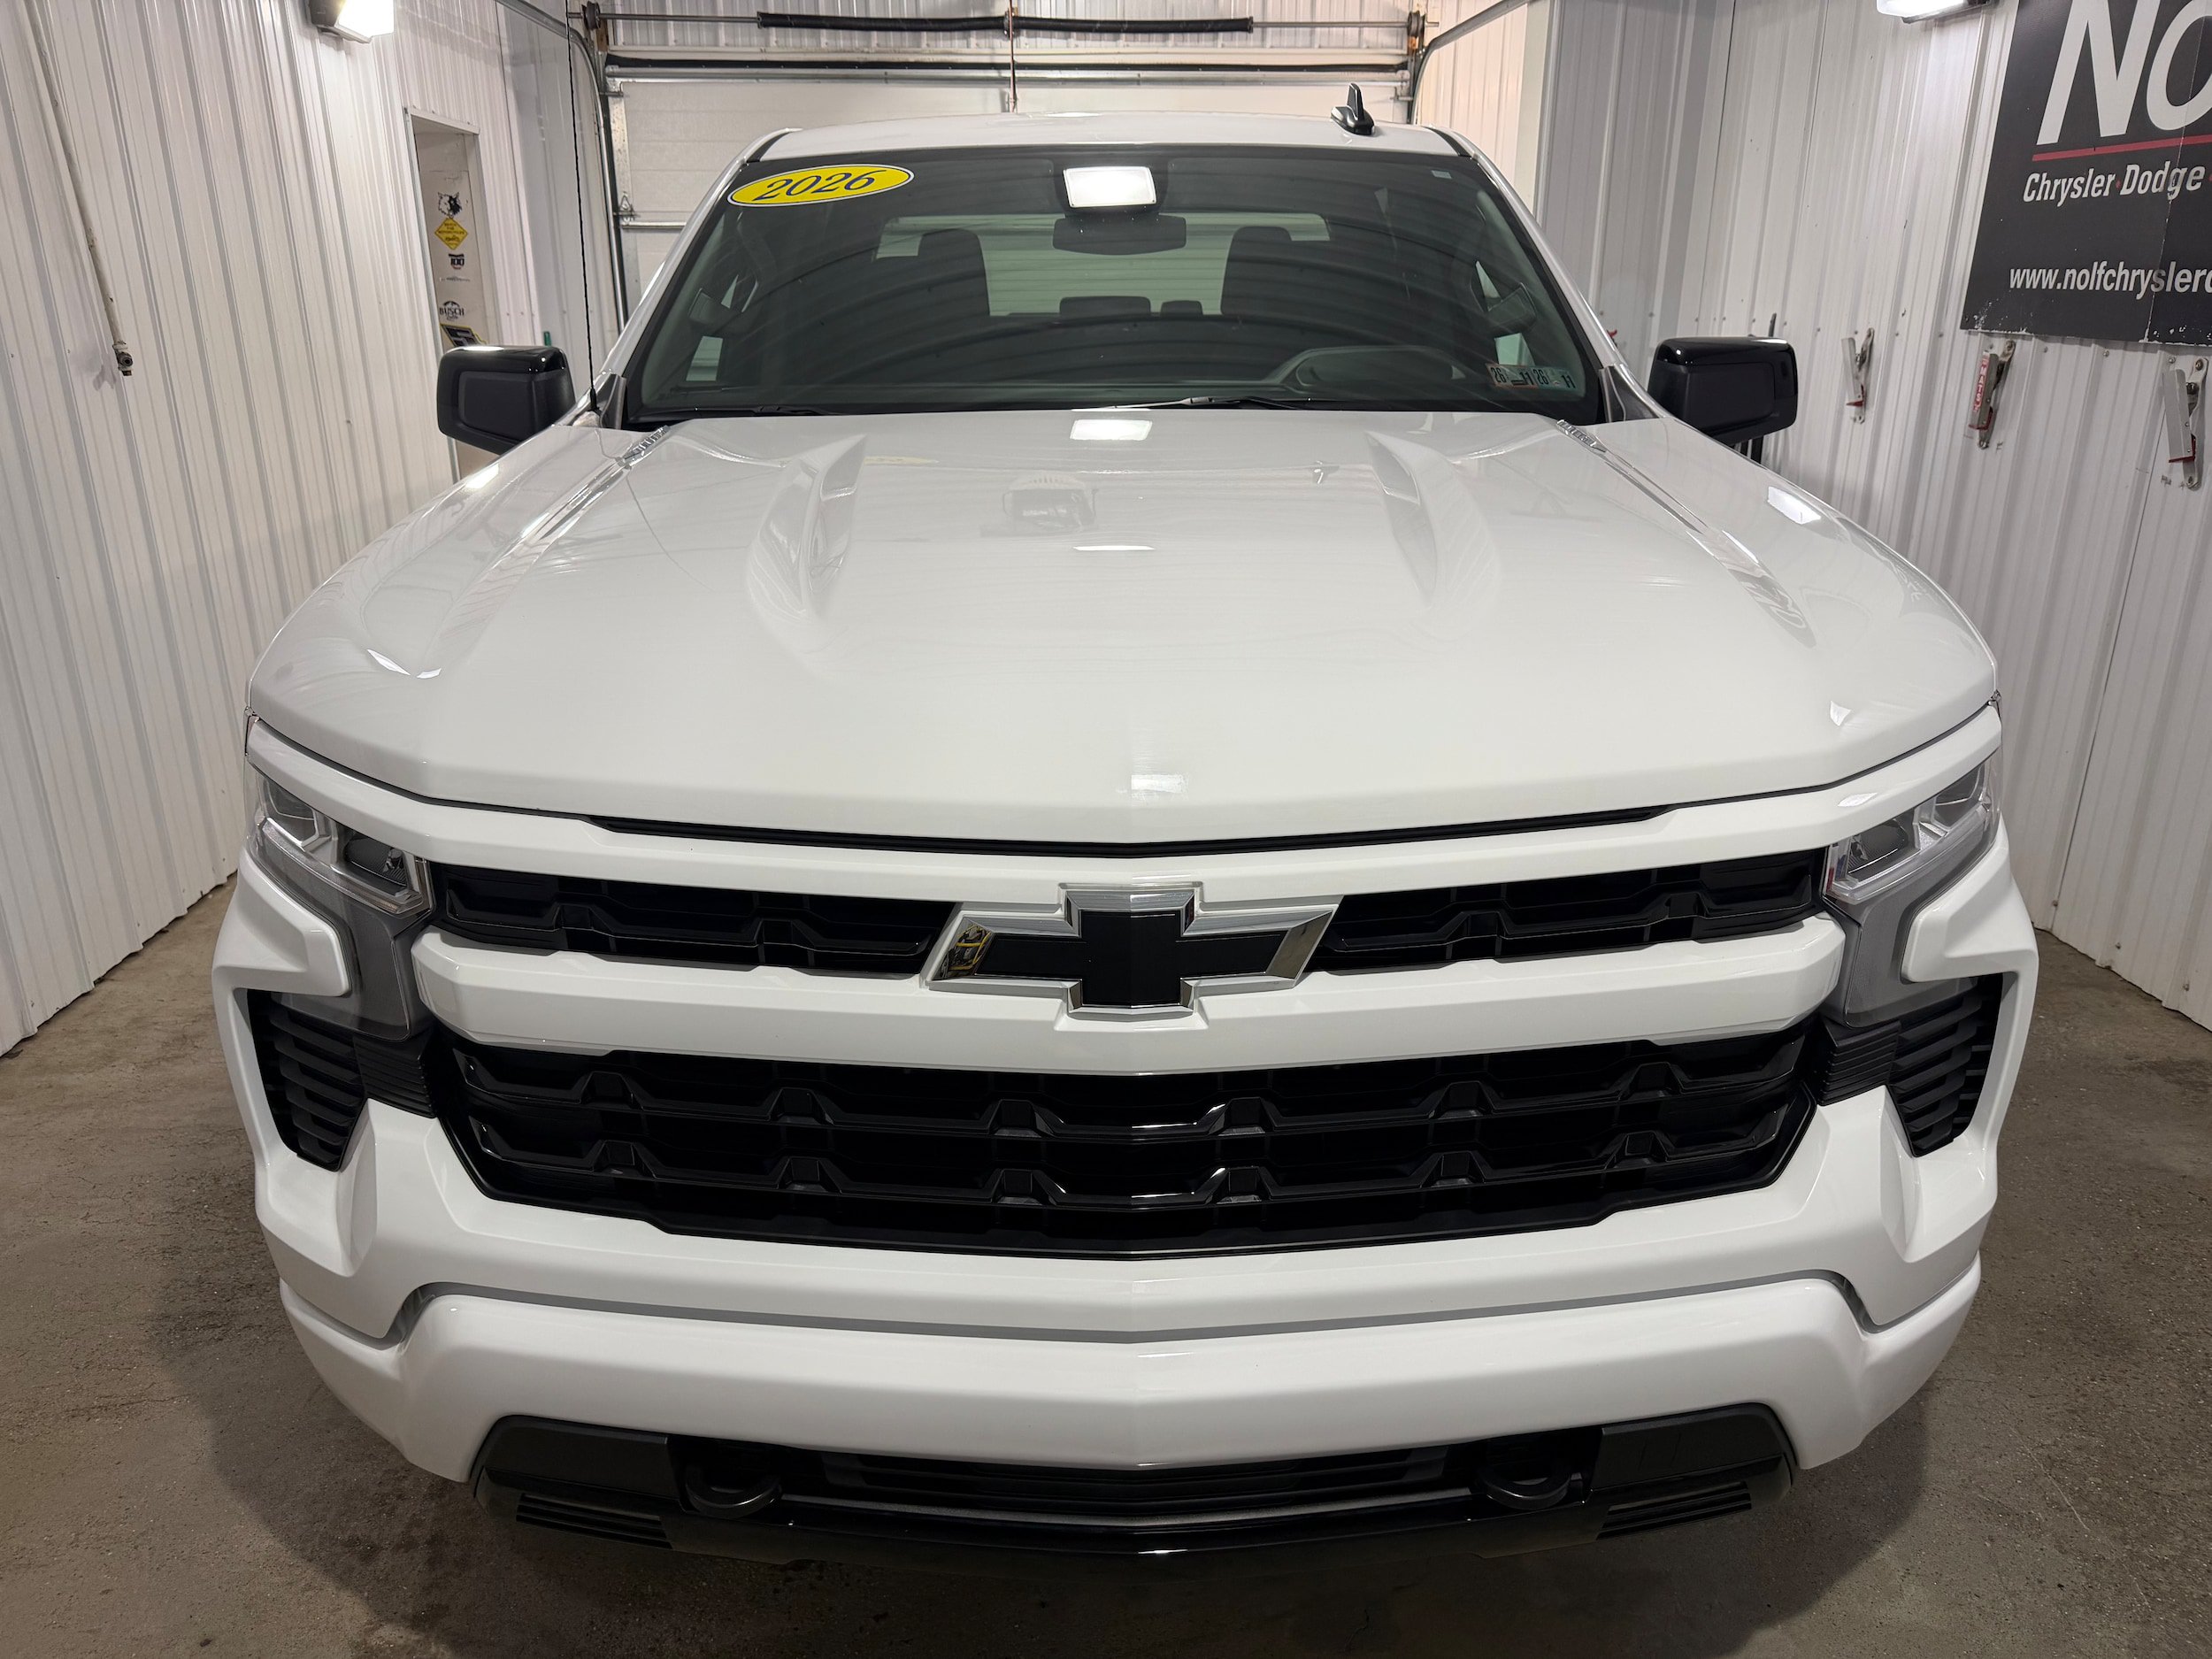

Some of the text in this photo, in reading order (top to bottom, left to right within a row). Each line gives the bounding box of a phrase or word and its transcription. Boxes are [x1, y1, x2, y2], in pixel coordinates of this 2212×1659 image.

[752, 170, 887, 201] 2026
[2023, 161, 2206, 207] Chrysler Dodge
[1491, 367, 1507, 383] 26
[1533, 369, 1549, 385] 26
